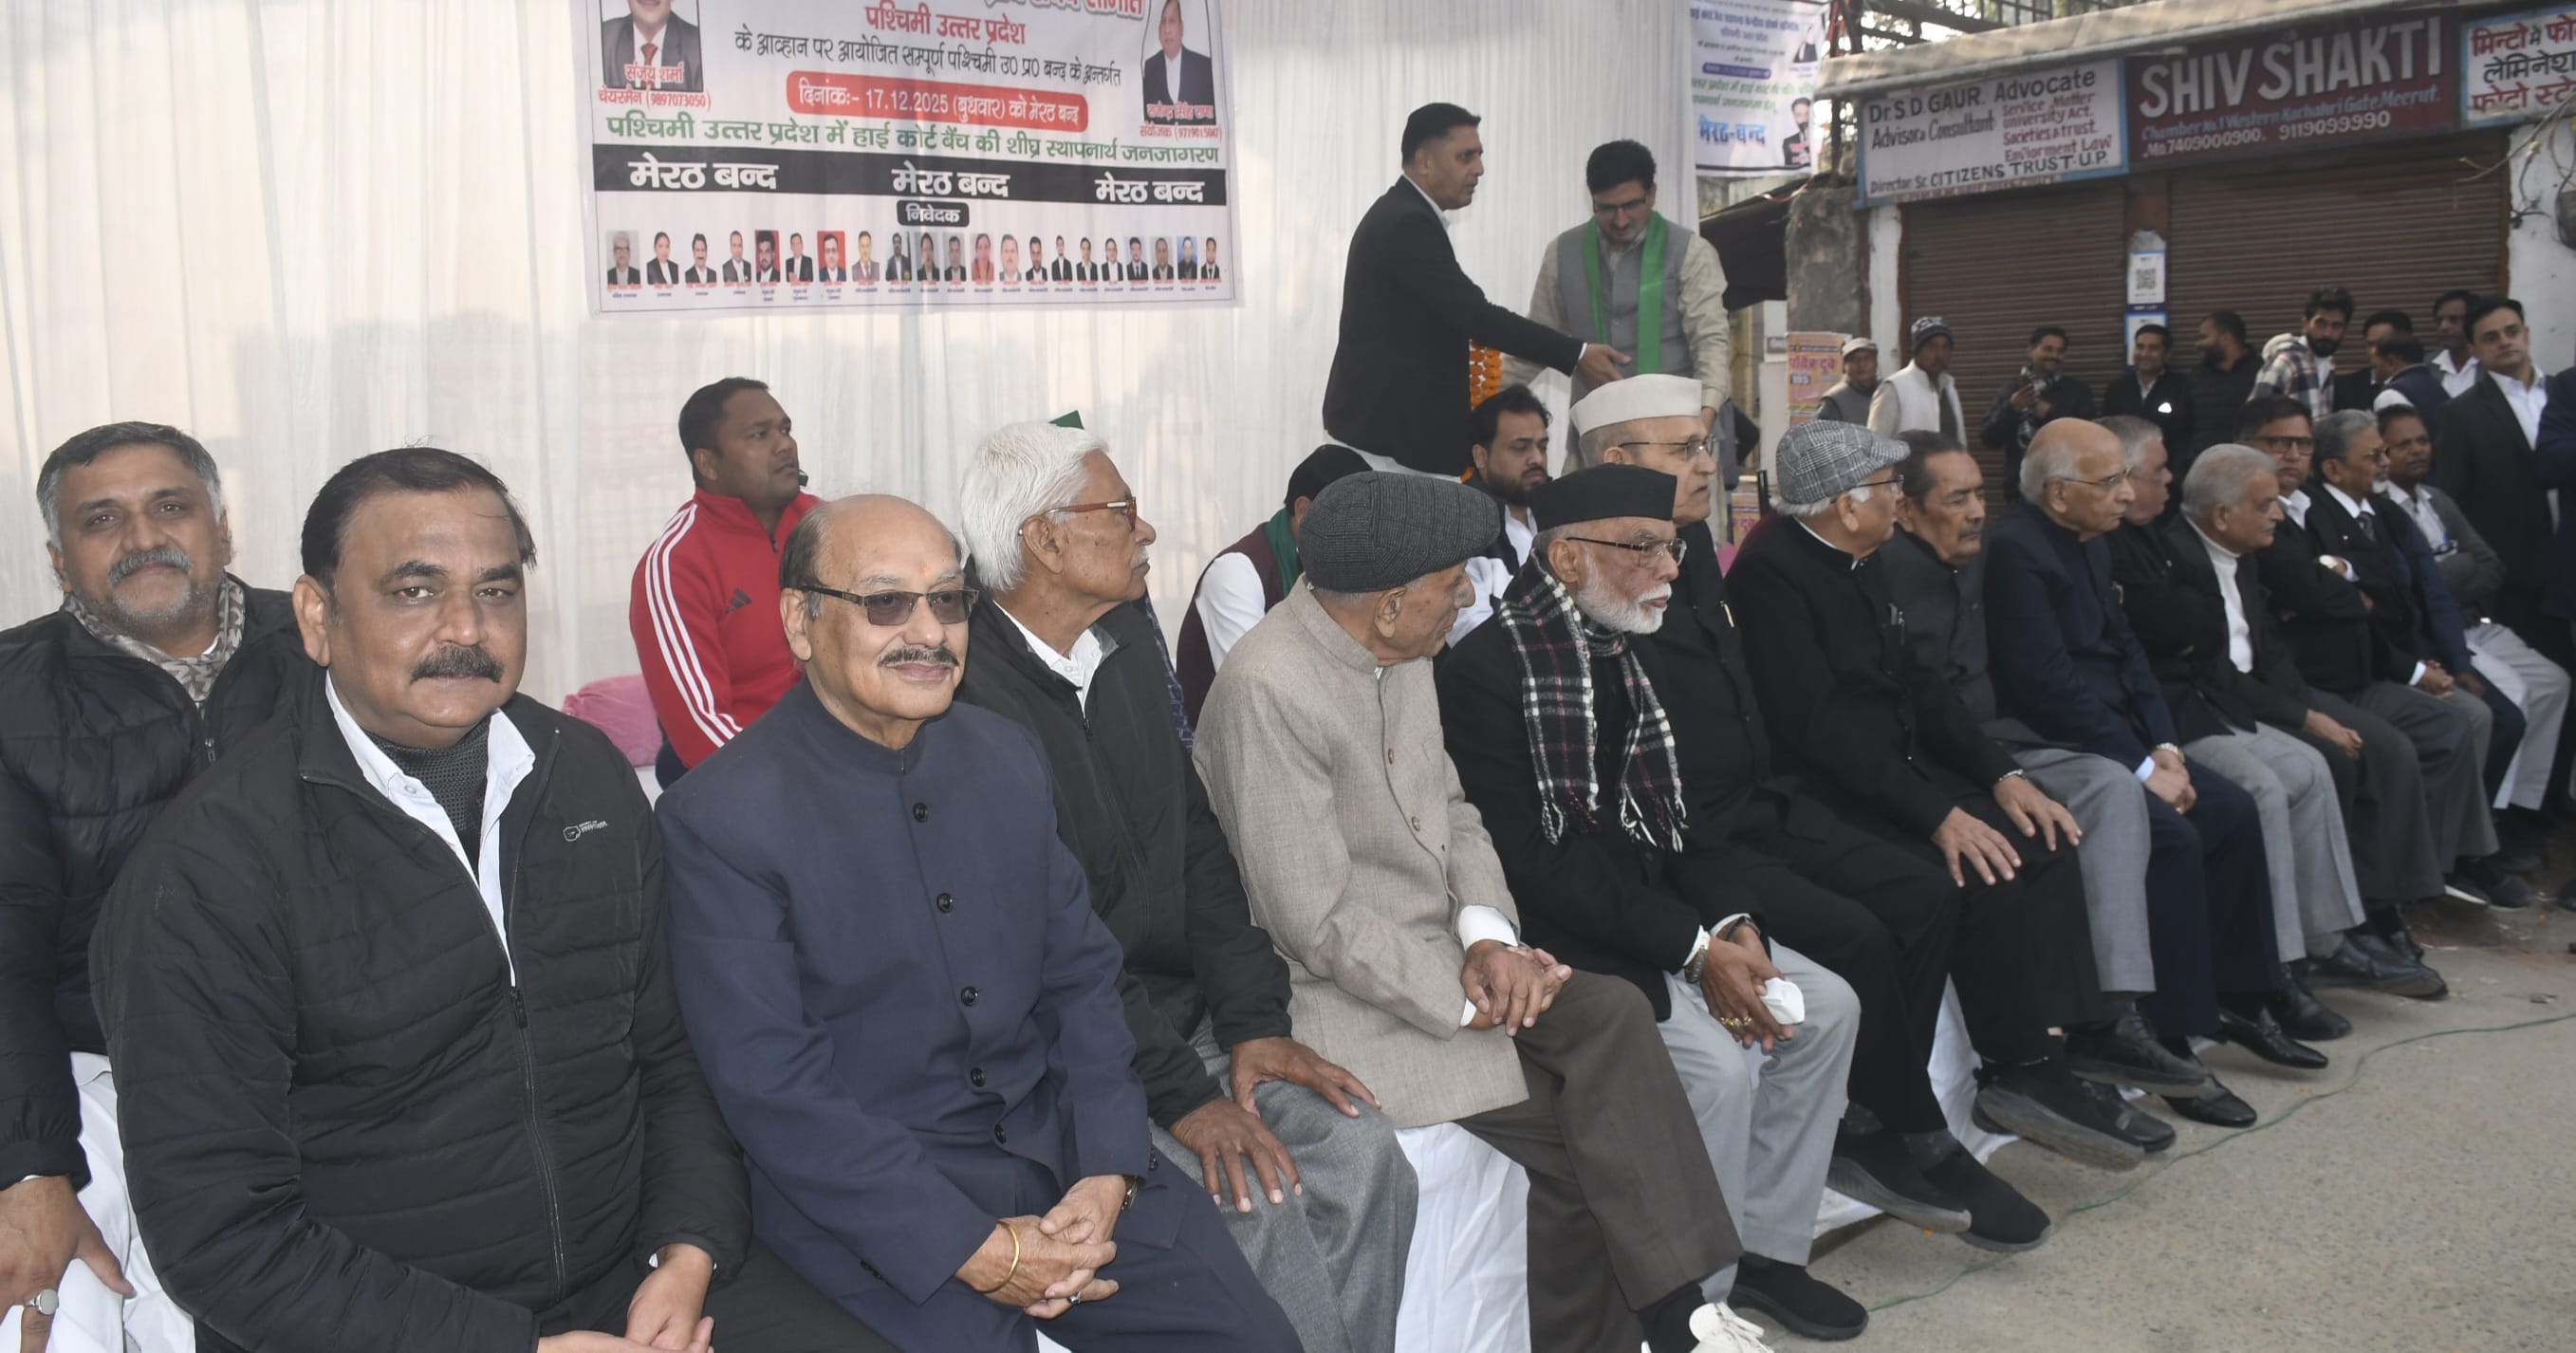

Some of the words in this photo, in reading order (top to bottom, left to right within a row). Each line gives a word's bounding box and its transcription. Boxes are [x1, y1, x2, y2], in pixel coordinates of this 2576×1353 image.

[865, 1, 931, 35] पश्चिमी
[936, 13, 981, 40] उत्तर
[985, 13, 1026, 45] प्रदेश
[2471, 22, 2529, 57] मिन्टो
[2545, 13, 2576, 44] फो
[734, 23, 752, 52] के
[758, 33, 808, 59] आव्हान
[813, 38, 835, 62] पर
[838, 34, 899, 65] आयोजित
[902, 42, 946, 77] सम्पूर्ण
[949, 44, 997, 74] पश्चिमी
[1044, 60, 1066, 82] बन्द
[1069, 56, 1083, 82] के
[2140, 48, 2253, 120] SHIV
[2257, 16, 2441, 102] SHAKTI
[2484, 49, 2576, 83] लेमिनेश
[659, 61, 685, 83] शर्मा
[1994, 69, 2095, 102] Advocate
[866, 88, 949, 114] 17.12.2025
[953, 94, 1006, 123] (बुधवार)
[1010, 94, 1028, 120] को
[1029, 96, 1056, 122] मेरठ
[1058, 103, 1079, 125] बन्द
[2472, 82, 2530, 112] फोटो
[2535, 75, 2576, 106] स्टे
[1928, 110, 1994, 141] Consultant
[2142, 120, 2202, 140] Chamber
[2225, 111, 2280, 130] Western
[2344, 94, 2378, 113] Gate
[2279, 110, 2391, 140] 9119099990
[606, 109, 695, 139] पश्चिमी
[702, 120, 762, 140] उत्तर
[769, 118, 819, 145] प्रदेश
[825, 120, 848, 144] में
[852, 121, 890, 149] हाई
[896, 122, 936, 150] कोर्ट
[975, 129, 1001, 154] की
[1007, 131, 1041, 158] शीघ्र
[1047, 138, 1118, 161] स्थापनार्थ
[1121, 145, 1219, 163] जनजागरण
[627, 152, 707, 189] मेरठ
[713, 162, 779, 190] बन्द
[891, 159, 953, 196] मेरठ
[956, 172, 1010, 198] बन्द
[1094, 172, 1148, 203] मेरठ
[1153, 181, 1205, 204] बन्द
[1930, 164, 2005, 188] CITIZENS
[905, 203, 961, 225] निवेदक
